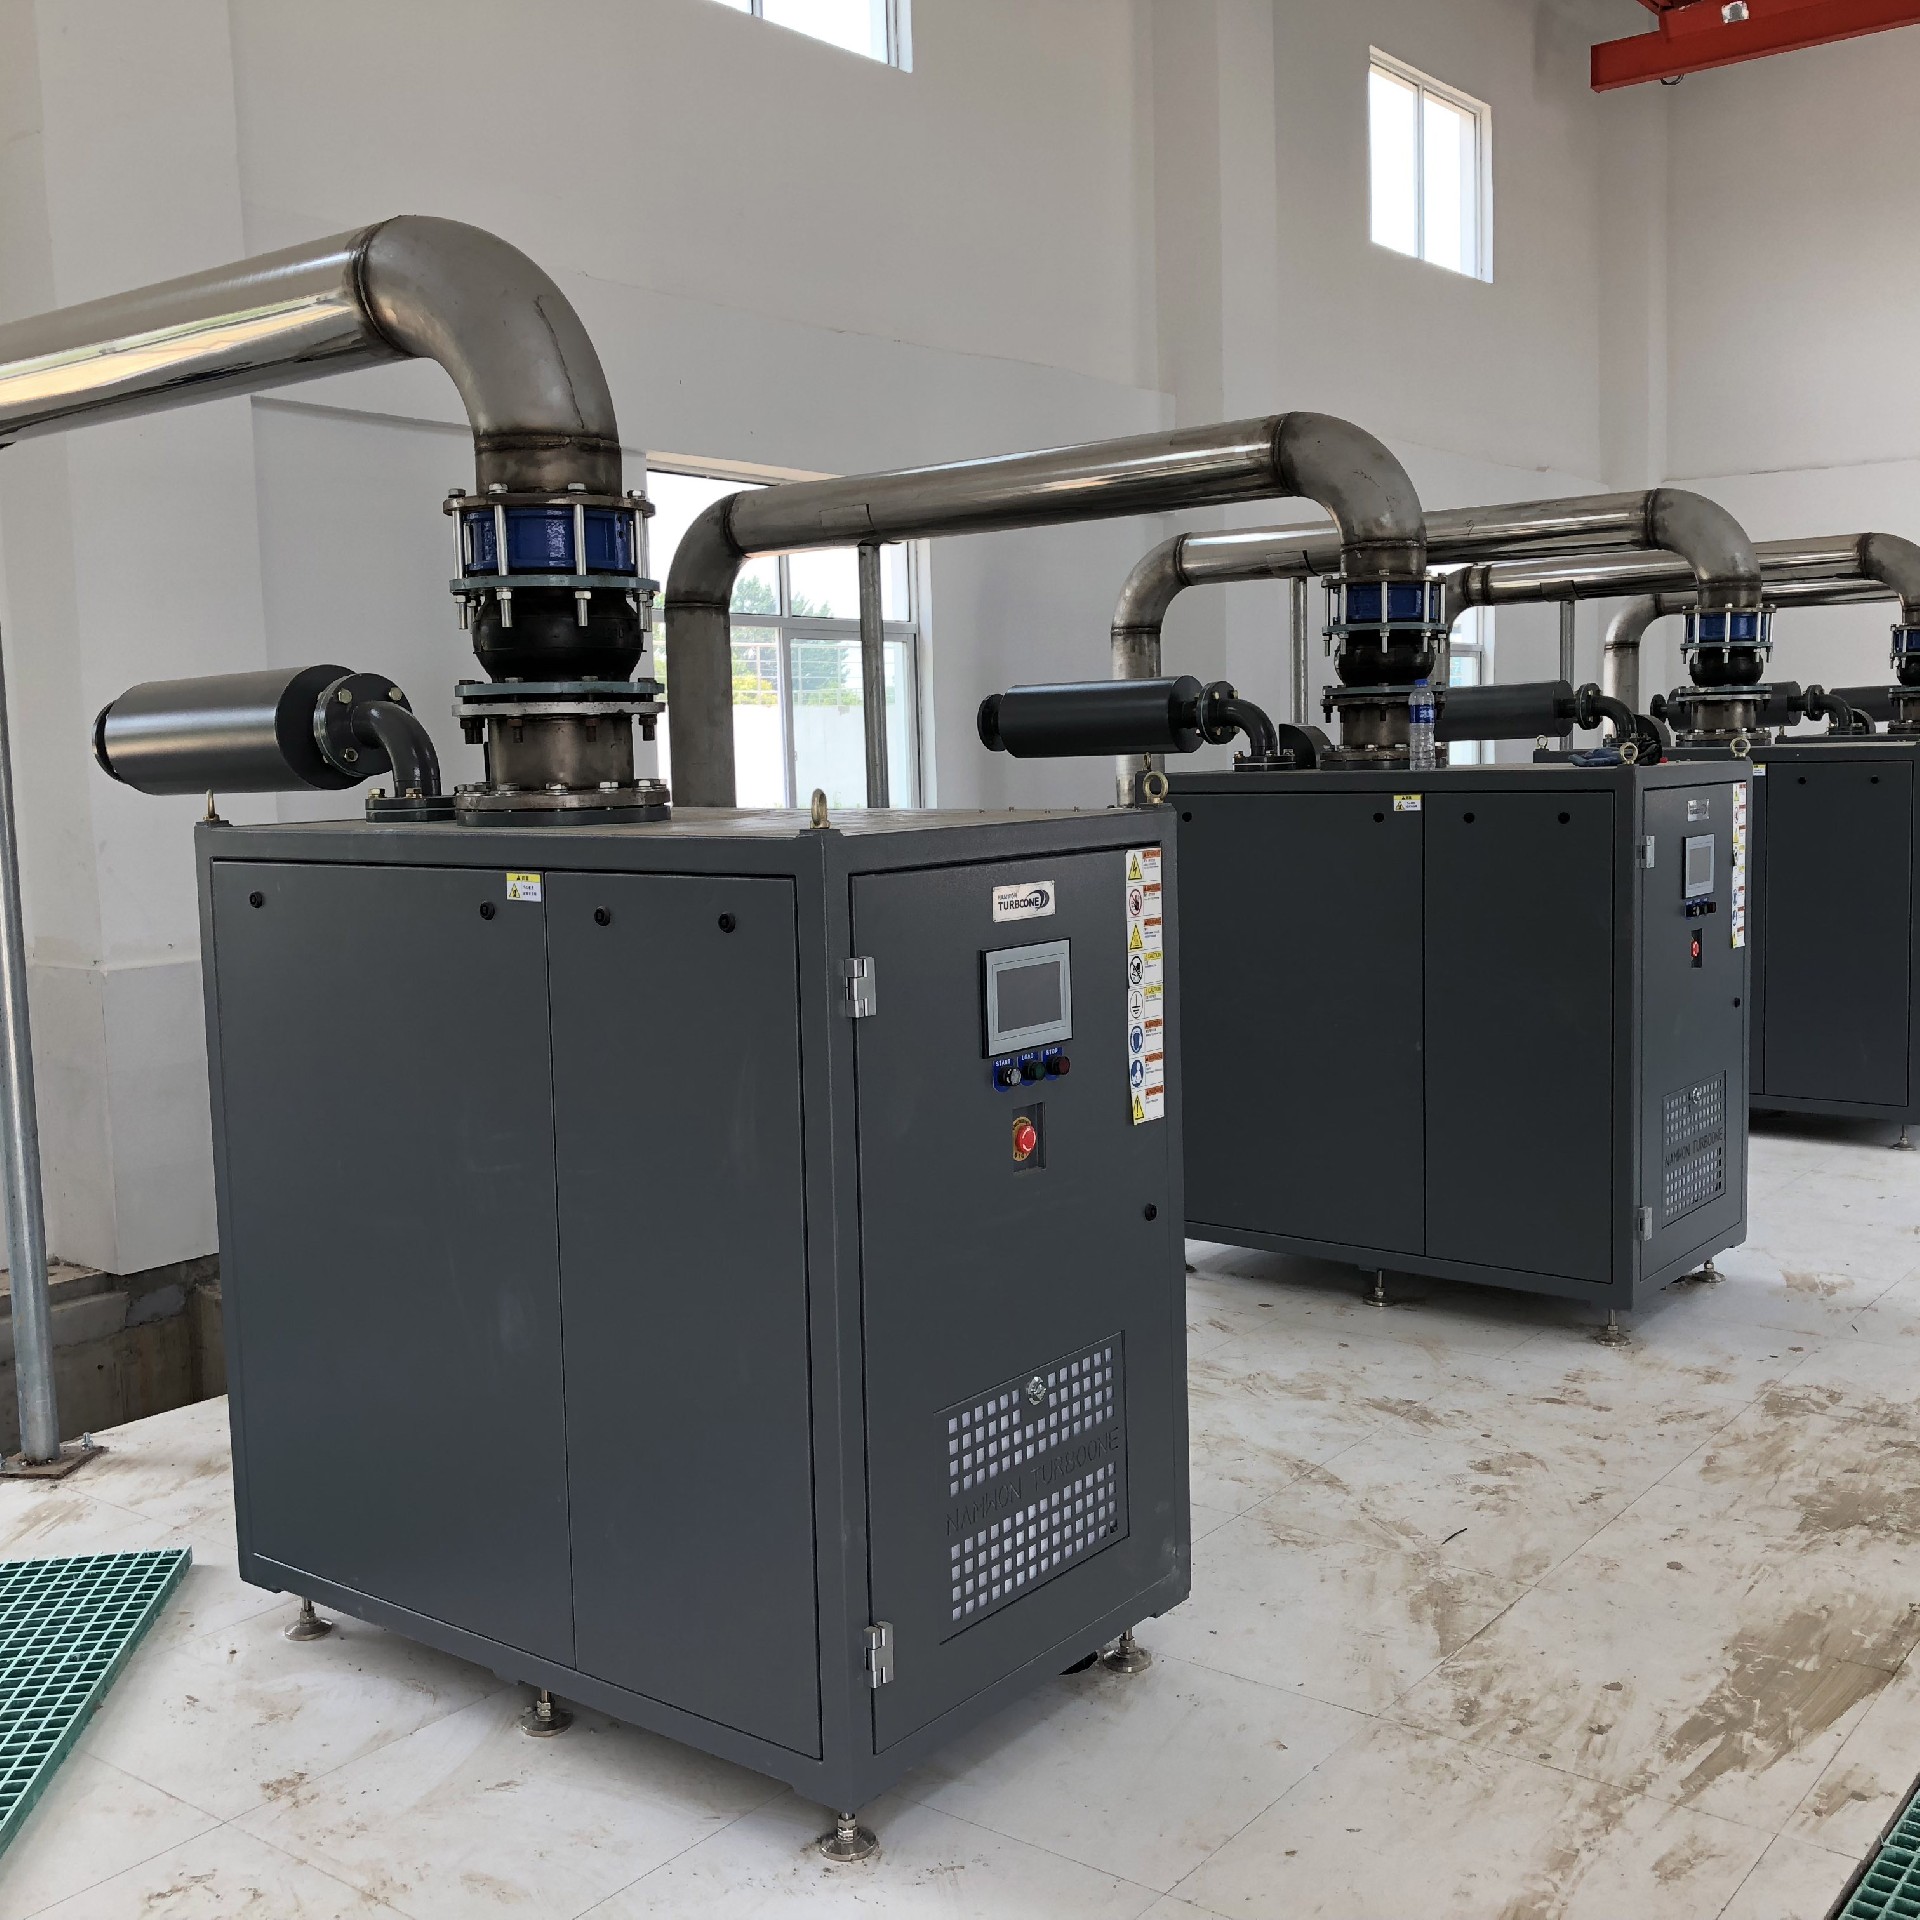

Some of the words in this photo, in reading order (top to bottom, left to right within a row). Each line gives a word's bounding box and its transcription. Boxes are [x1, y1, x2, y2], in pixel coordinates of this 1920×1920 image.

[1045, 1047, 1058, 1056] STOP
[995, 1058, 1011, 1067] START
[1030, 1426, 1119, 1492] TURBOONE
